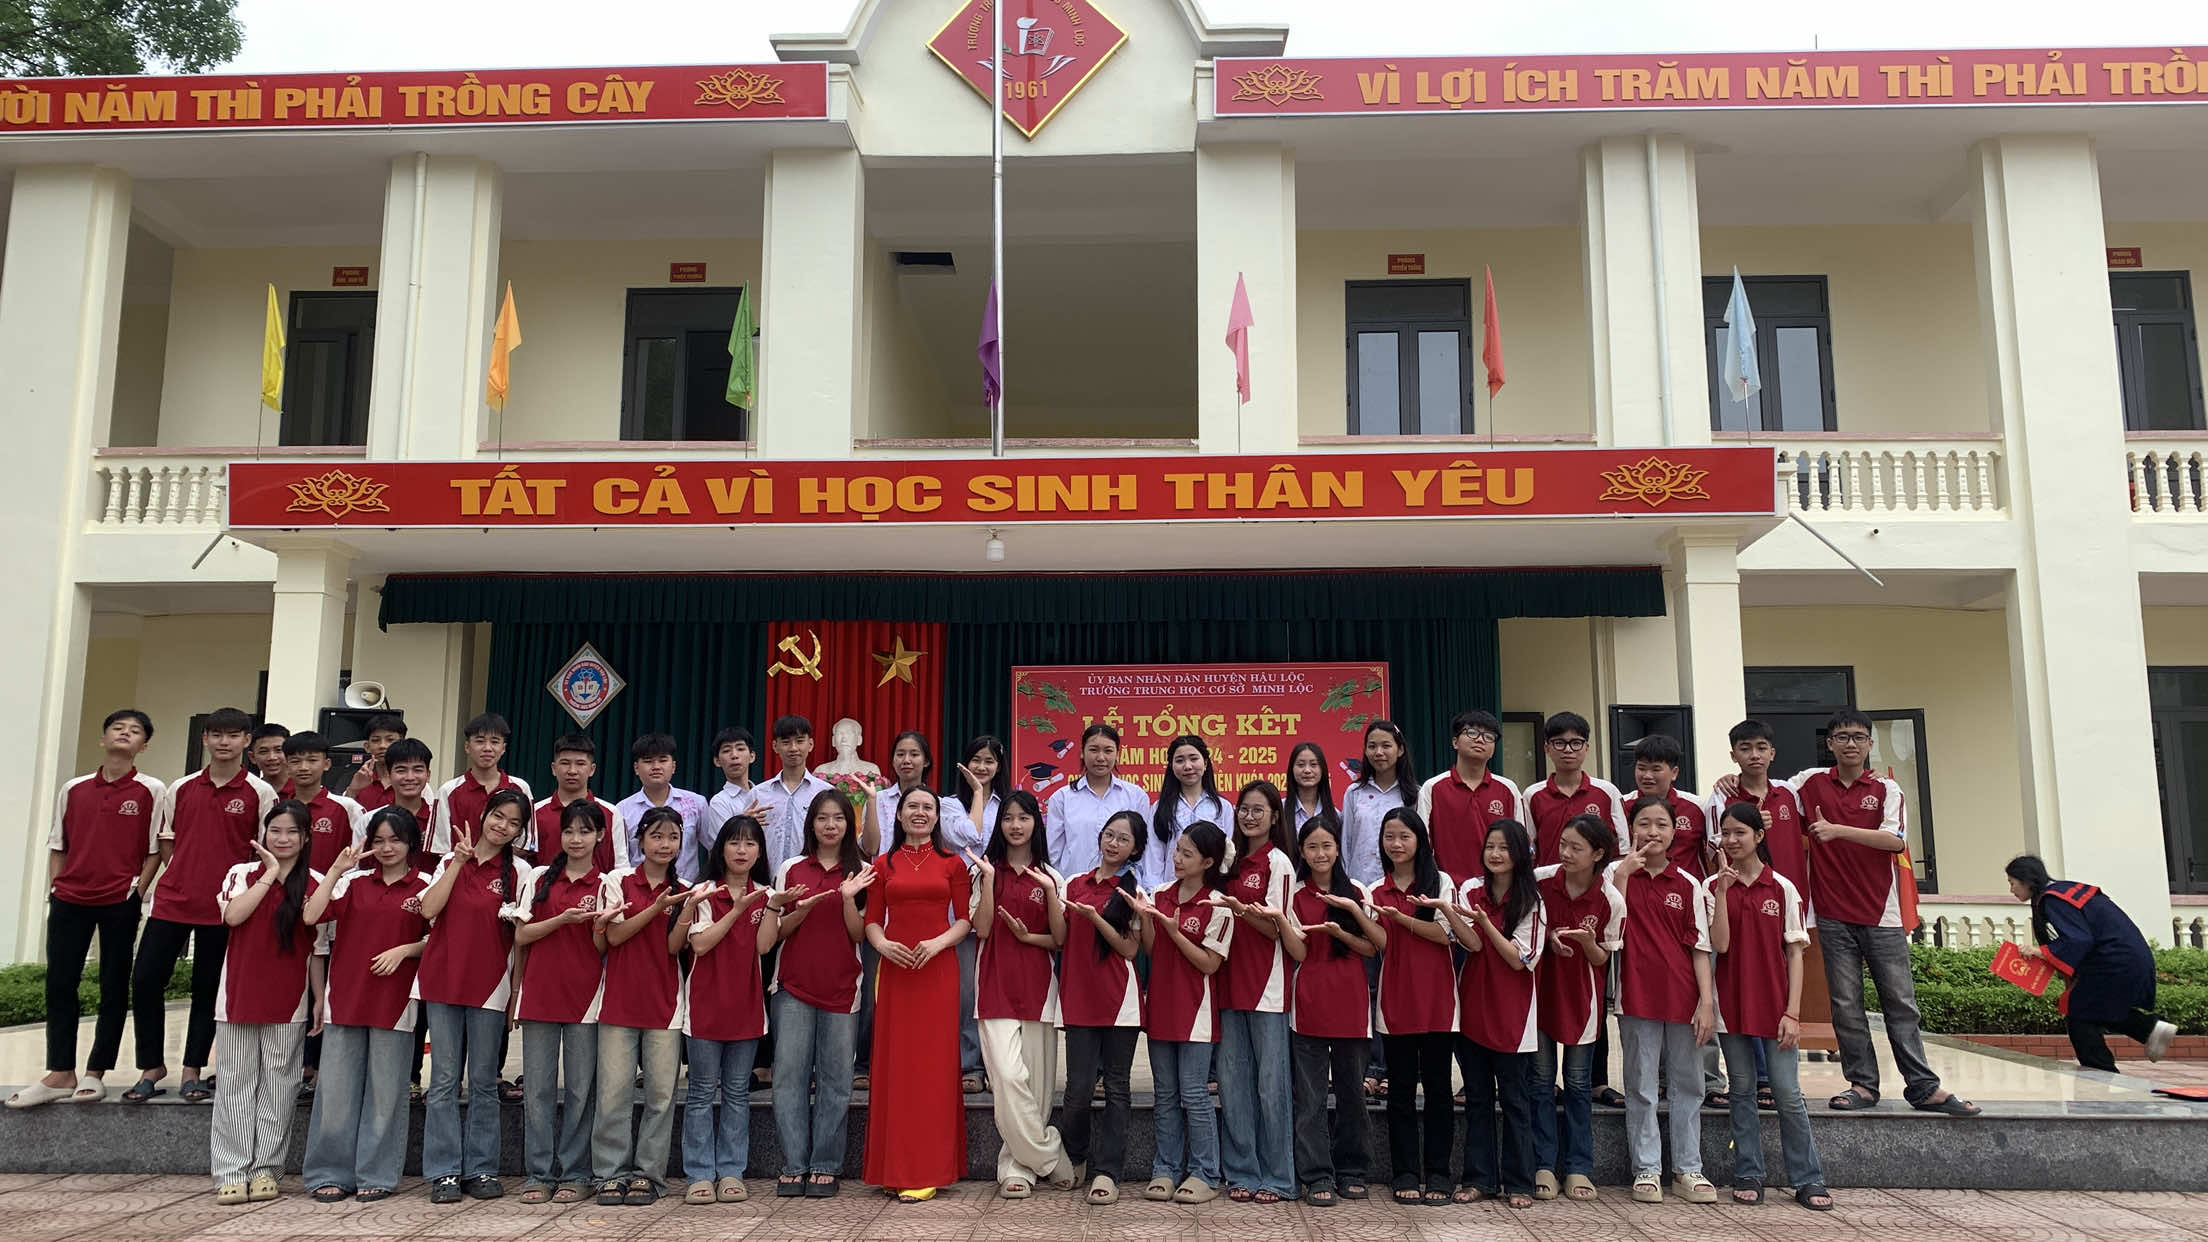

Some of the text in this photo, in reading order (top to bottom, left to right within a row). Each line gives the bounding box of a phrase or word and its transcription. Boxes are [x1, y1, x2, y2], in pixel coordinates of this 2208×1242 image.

[1004, 79, 1049, 100] 1961
[1357, 48, 2208, 110] VÌ LỢI ÍCH TRĂM NĂM THÌ PHẢI TRỒ
[0, 72, 655, 124] ỜI NĂM THÌ PHẢI TRỒNG CÂY
[450, 460, 1535, 521] TẤT CẢ VÌ HỌC SINH THÂN YÊU
[1080, 682, 1314, 696] TRƯỜNG TRUNG HỌC CƠ SỞ MINH LỘC
[1108, 675, 1133, 684] BAN
[1136, 673, 1171, 684] NHÂN
[1175, 673, 1201, 683] DÂN
[1204, 672, 1247, 685] HUYỆN
[1250, 672, 1277, 684] HẬU
[1281, 671, 1305, 684] LỘC
[1133, 704, 1228, 737] TỔNG
[1236, 704, 1302, 737] KẾT
[1117, 744, 1144, 765] ĂM
[1149, 747, 1168, 769] HỌ
[1239, 747, 1277, 764] 2025
[1142, 773, 1165, 792] SIN
